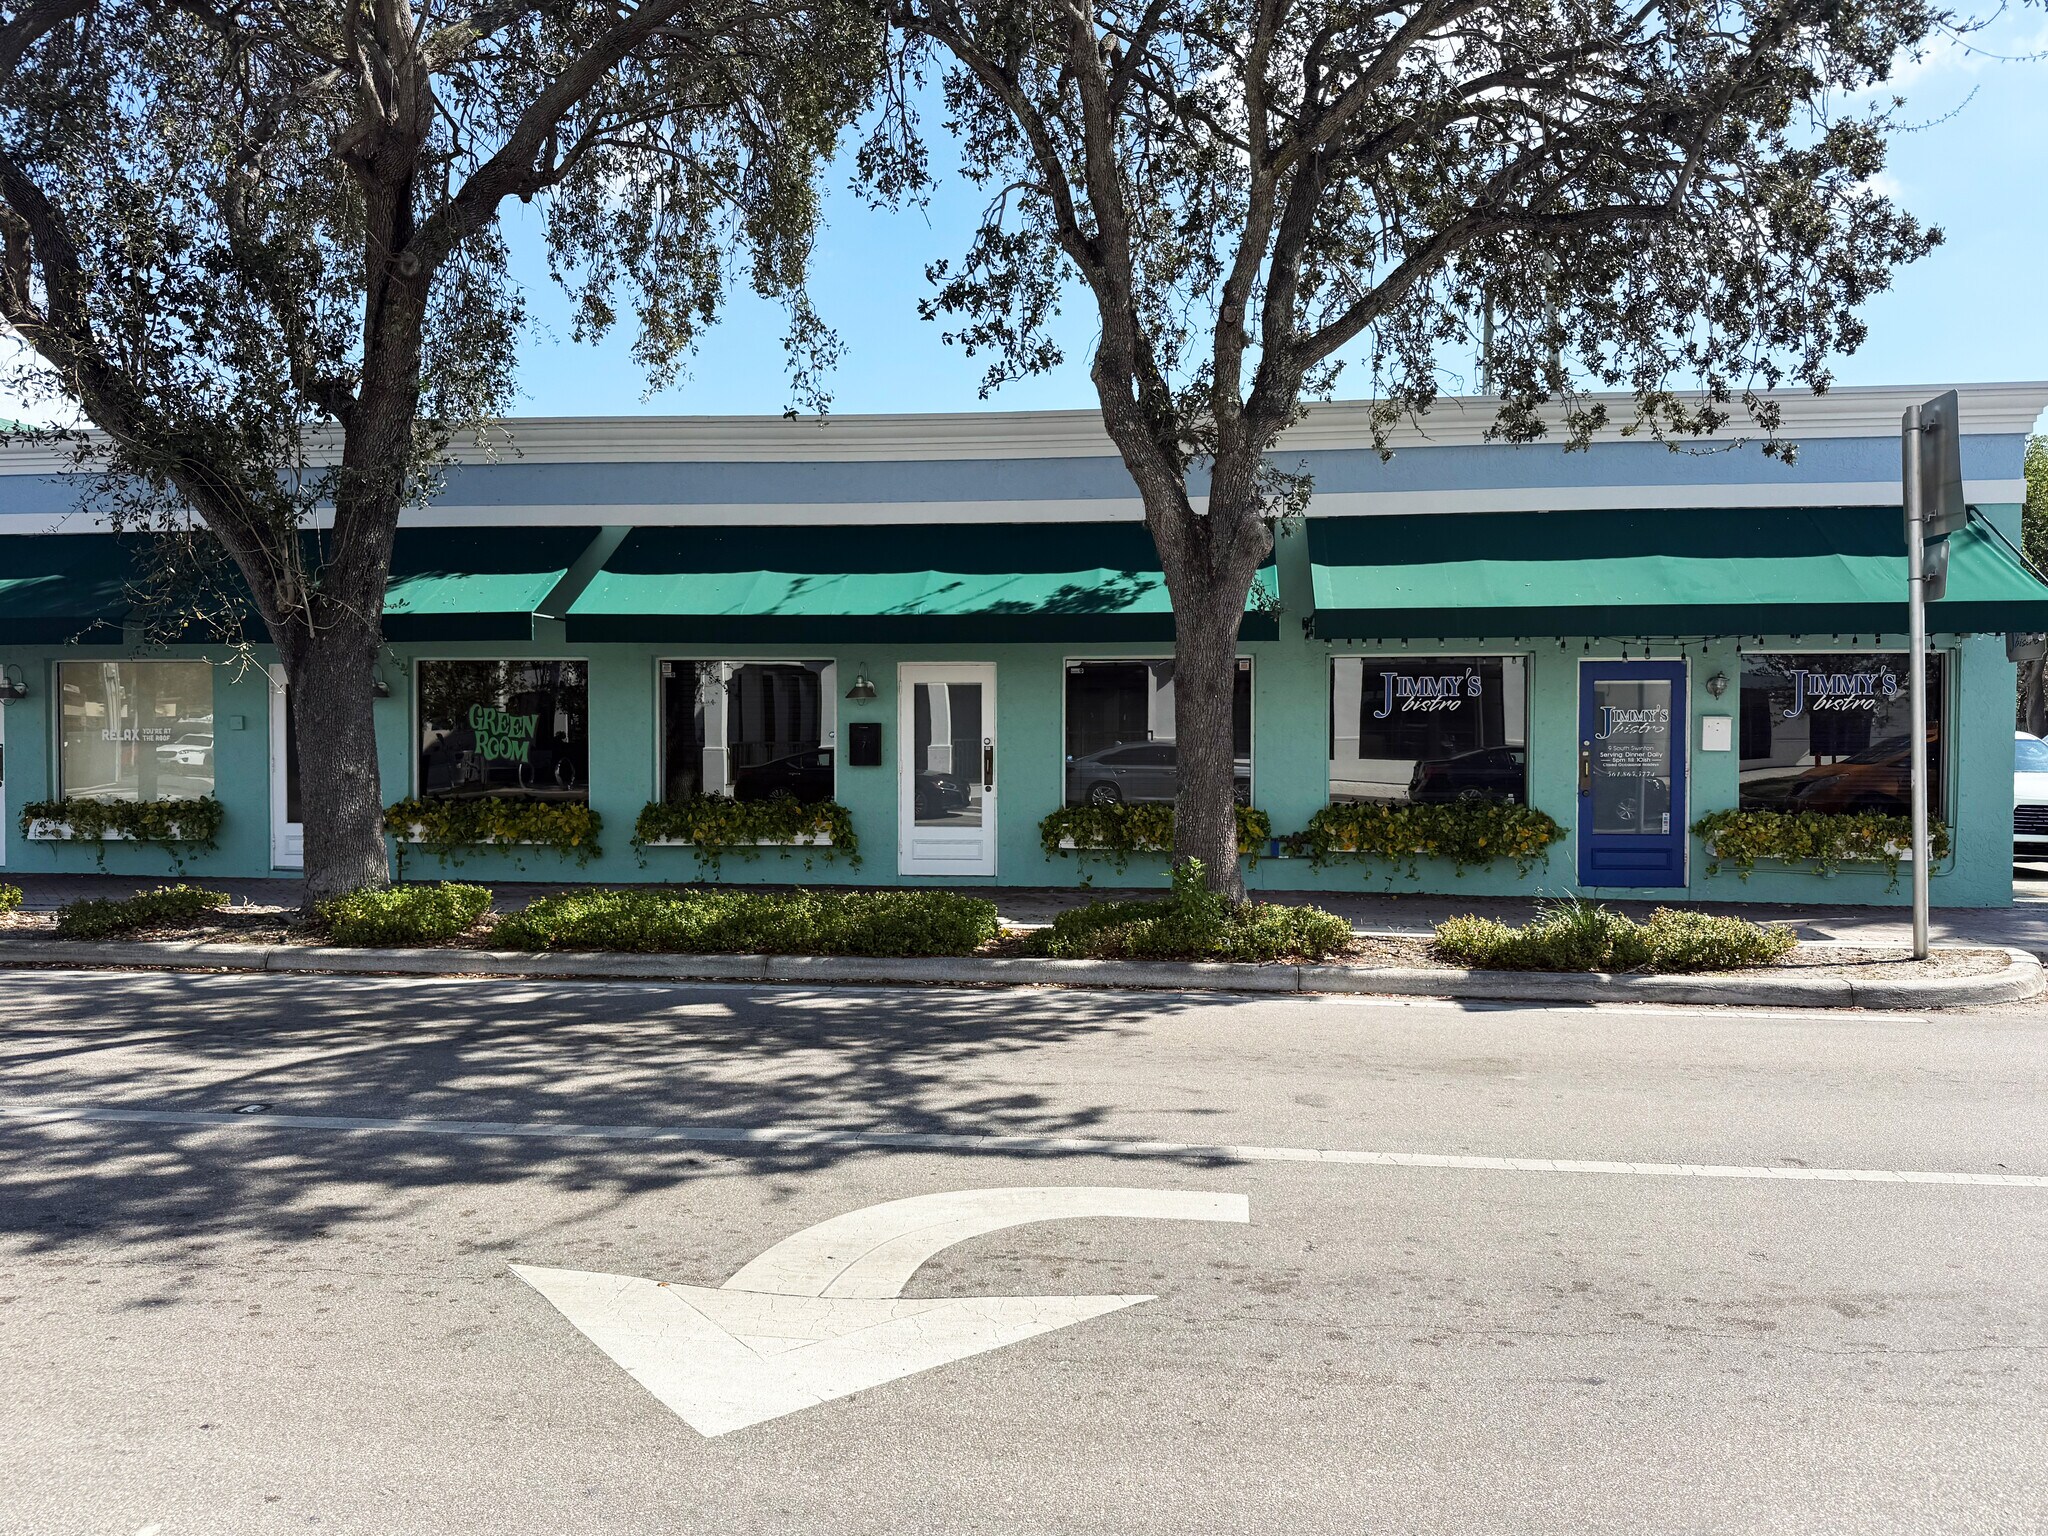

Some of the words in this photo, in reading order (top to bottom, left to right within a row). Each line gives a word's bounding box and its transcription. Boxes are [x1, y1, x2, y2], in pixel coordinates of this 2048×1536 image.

[1373, 667, 1482, 719] JIMMY'S
[1401, 695, 1462, 712] bistro
[1783, 665, 1898, 717] JIMMY'S
[1812, 693, 1876, 711] bistro
[101, 728, 140, 741] RELAX
[469, 703, 539, 738] GREEN
[1594, 704, 1669, 739] JIMMY'S
[1612, 722, 1665, 734] bistro
[474, 730, 530, 763] ROOM
